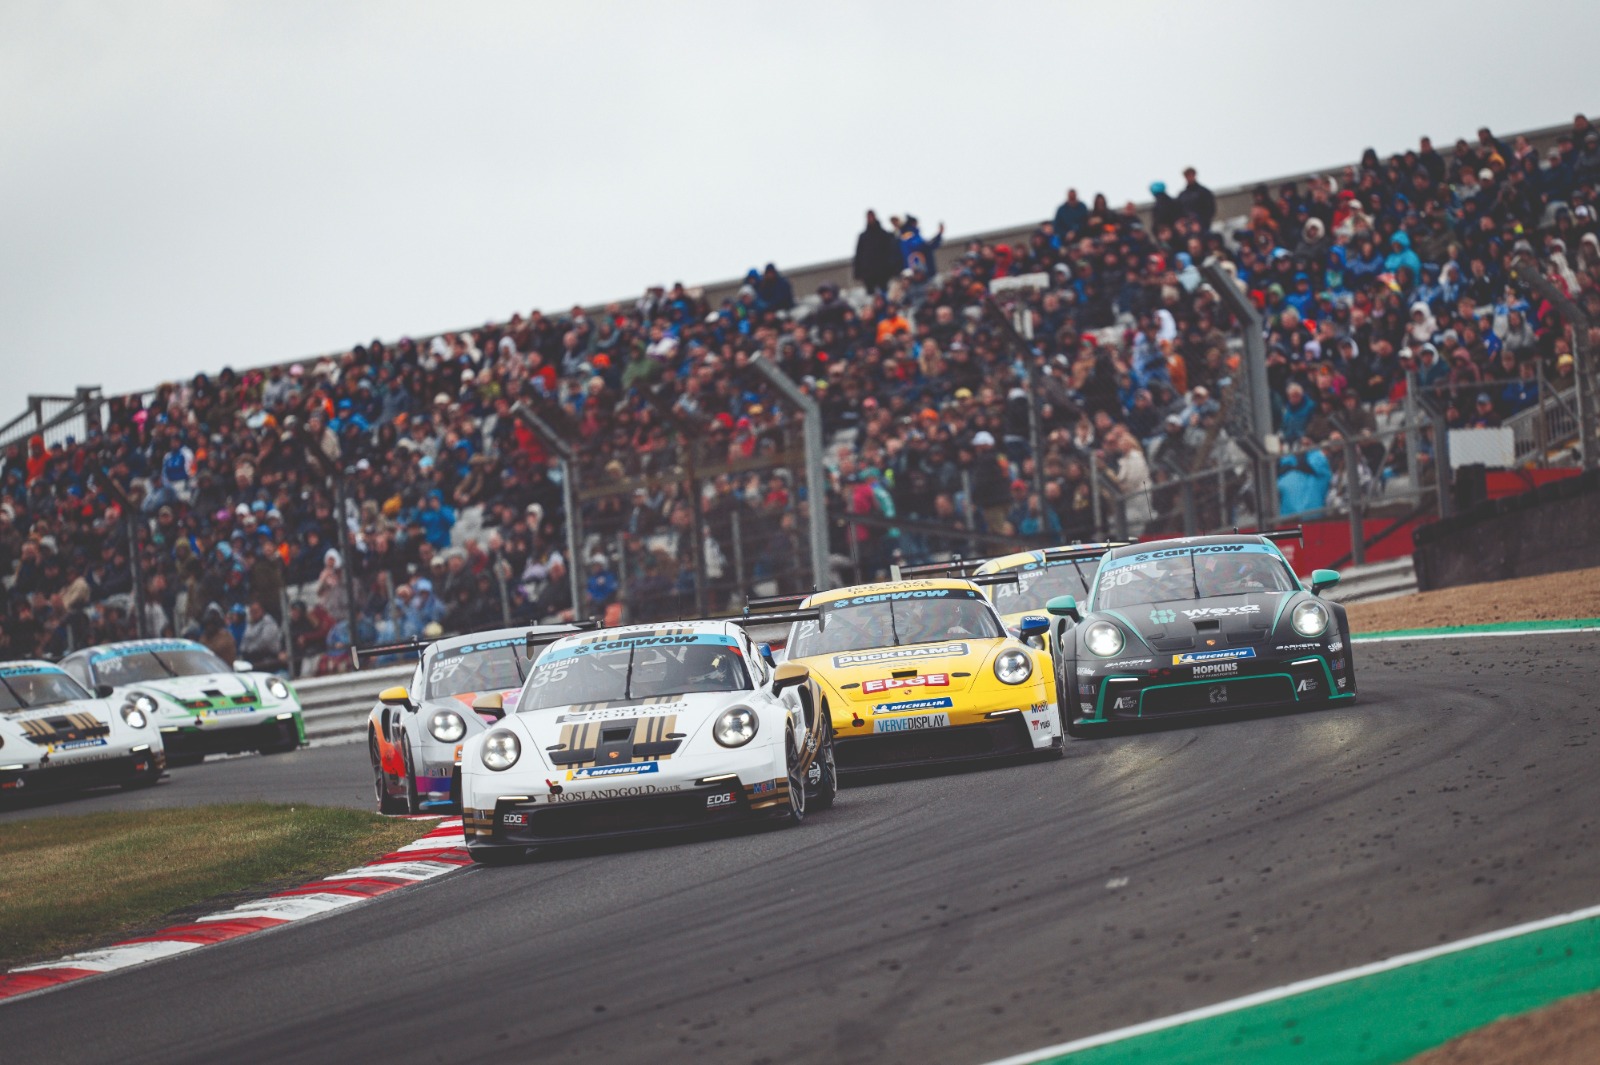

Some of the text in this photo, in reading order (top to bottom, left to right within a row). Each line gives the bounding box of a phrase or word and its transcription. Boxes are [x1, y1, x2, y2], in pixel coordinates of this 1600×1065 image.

[1152, 545, 1244, 558] carwow
[1102, 562, 1148, 579] Jenkins
[1100, 571, 1133, 591] 30
[852, 590, 949, 605] carwow
[1181, 604, 1260, 617] Wera
[476, 638, 527, 650] carw
[593, 635, 699, 651] carwow
[838, 646, 963, 664] DUCKHAMS
[1196, 650, 1248, 660] MICHELIN
[433, 656, 465, 670] Jelley
[538, 656, 579, 672] Voisin
[1192, 662, 1238, 674] HOPKINS
[429, 662, 460, 683] 67
[531, 666, 569, 689] 35
[865, 674, 946, 692] EDGE
[891, 700, 945, 711] MICHELIN
[878, 714, 945, 732] VERVEDISPLAY
[591, 765, 651, 776] MICHELIN
[707, 792, 737, 805] EDGE
[503, 813, 528, 823] EDGE
